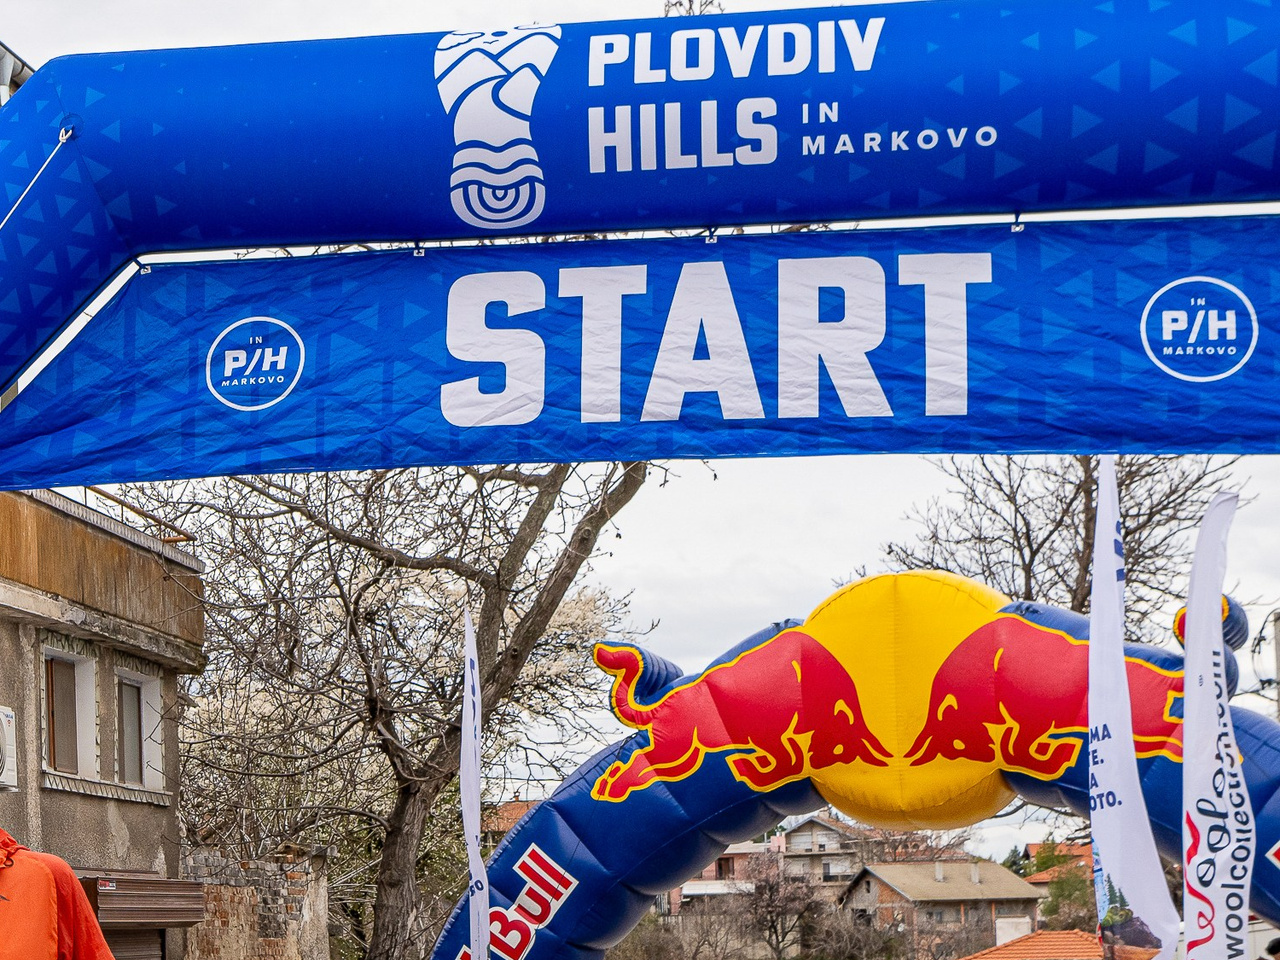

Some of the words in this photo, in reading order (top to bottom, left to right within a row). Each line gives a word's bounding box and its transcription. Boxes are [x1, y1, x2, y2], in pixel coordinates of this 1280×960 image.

[588, 18, 887, 87] PLOVDIV
[802, 102, 839, 123] IN
[588, 97, 778, 174] HILLS
[802, 126, 998, 156] MARKOVO
[1190, 297, 1206, 306] IN
[249, 336, 263, 344] IN
[440, 252, 993, 428] START
[1162, 309, 1237, 343] P/H
[224, 346, 288, 377] P/H
[1162, 346, 1237, 355] MARKOVO
[221, 375, 284, 387] MARKOVO
